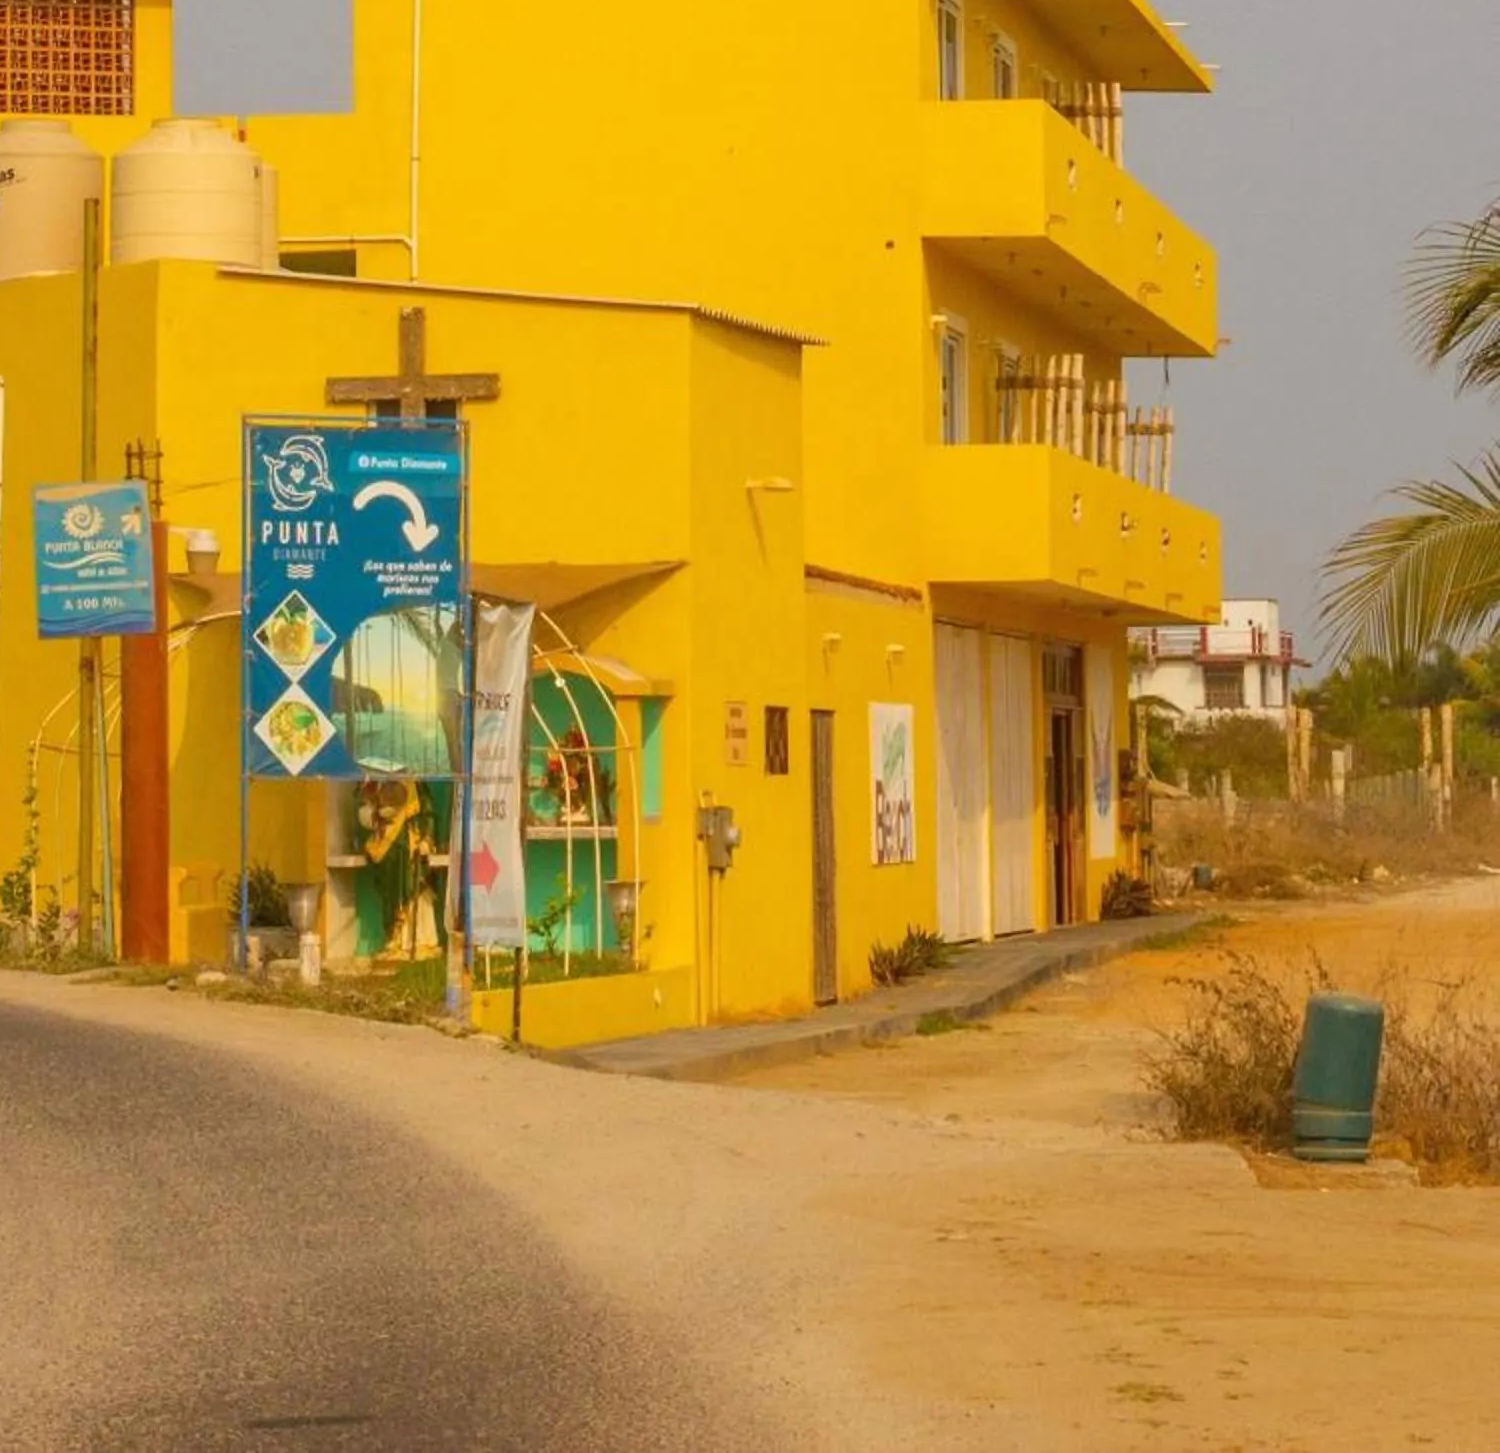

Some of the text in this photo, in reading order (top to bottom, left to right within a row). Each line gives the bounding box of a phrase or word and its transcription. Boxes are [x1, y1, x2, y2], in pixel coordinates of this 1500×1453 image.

[371, 455, 448, 470] Punta Diamante
[261, 521, 340, 544] PUNTA
[83, 538, 124, 552] BLANCA
[272, 547, 327, 561] DIAMANTE
[77, 598, 100, 610] 100
